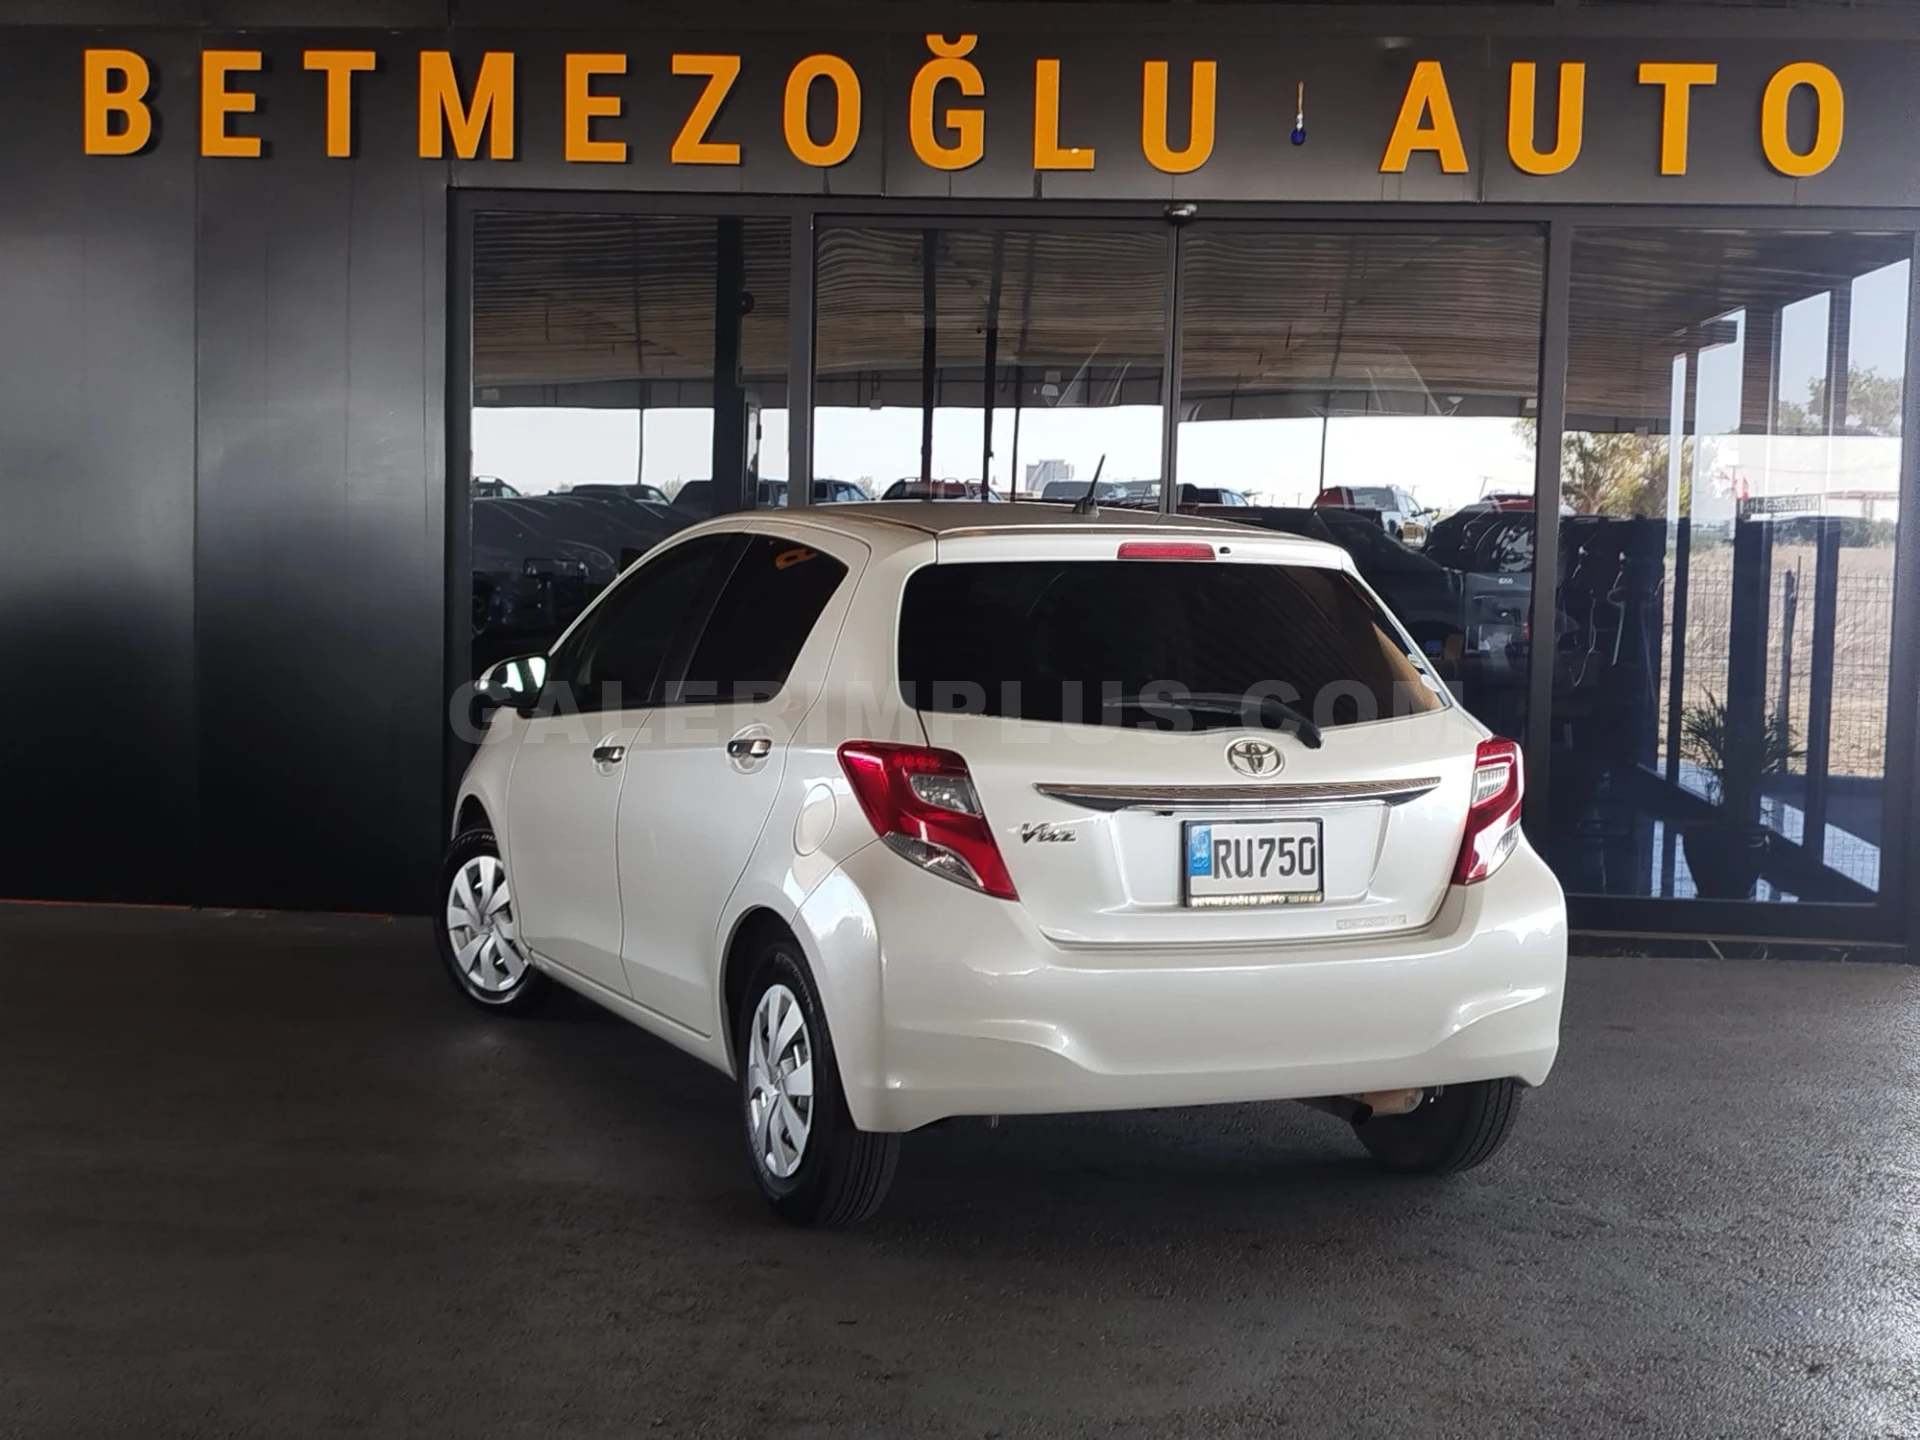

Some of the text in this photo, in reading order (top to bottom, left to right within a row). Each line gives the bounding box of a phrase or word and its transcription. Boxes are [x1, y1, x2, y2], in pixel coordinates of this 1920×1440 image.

[84, 34, 1844, 176] BETMEZOĞLU AUTO
[1021, 822, 1076, 844] Vitz
[1213, 836, 1316, 879] RU750
